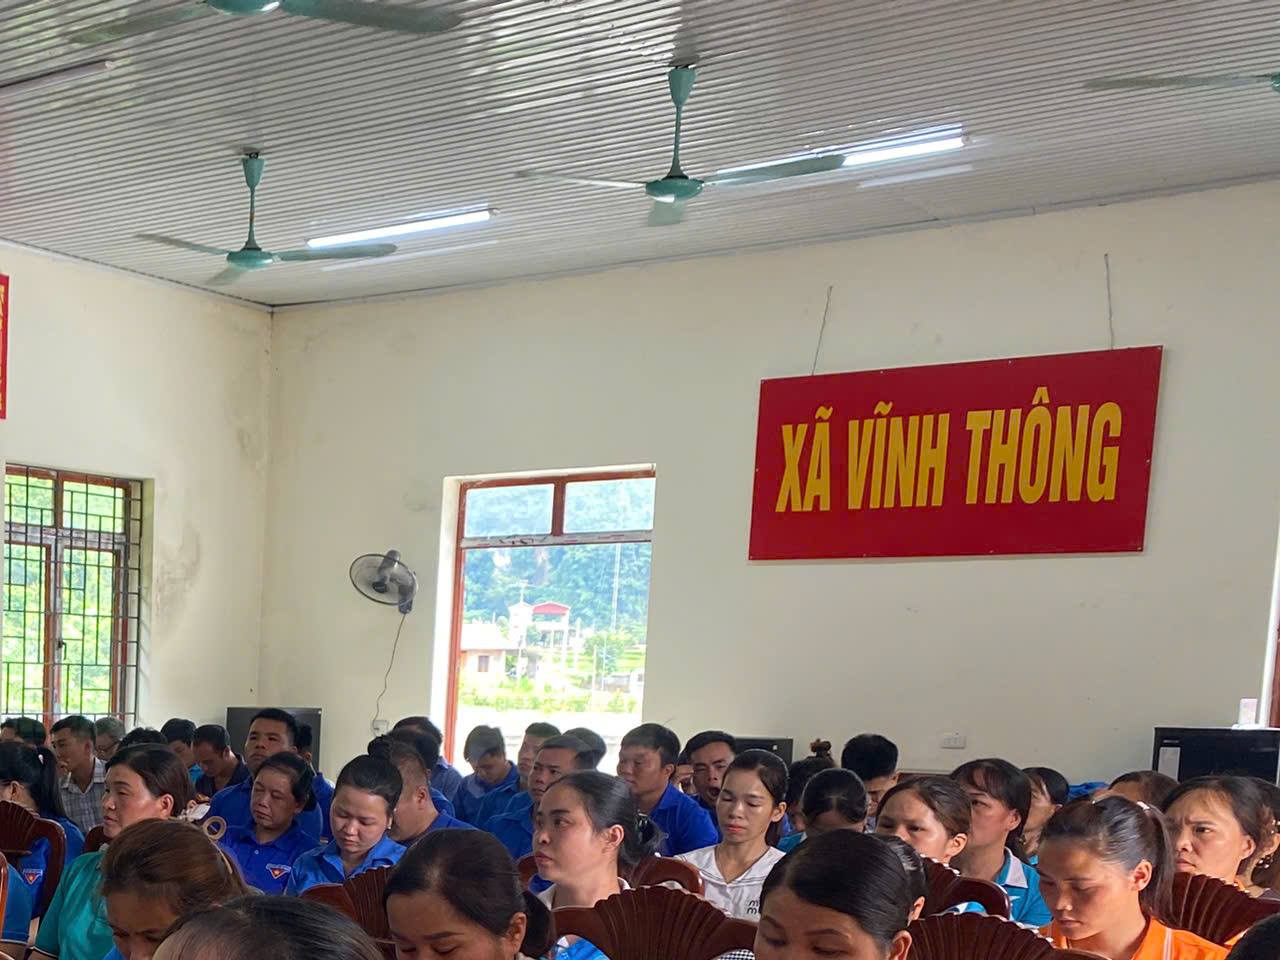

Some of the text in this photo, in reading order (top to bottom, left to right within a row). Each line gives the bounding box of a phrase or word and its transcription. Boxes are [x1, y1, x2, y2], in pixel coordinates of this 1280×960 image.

[775, 386, 1122, 513] XÃ VĨNH THÔNG
